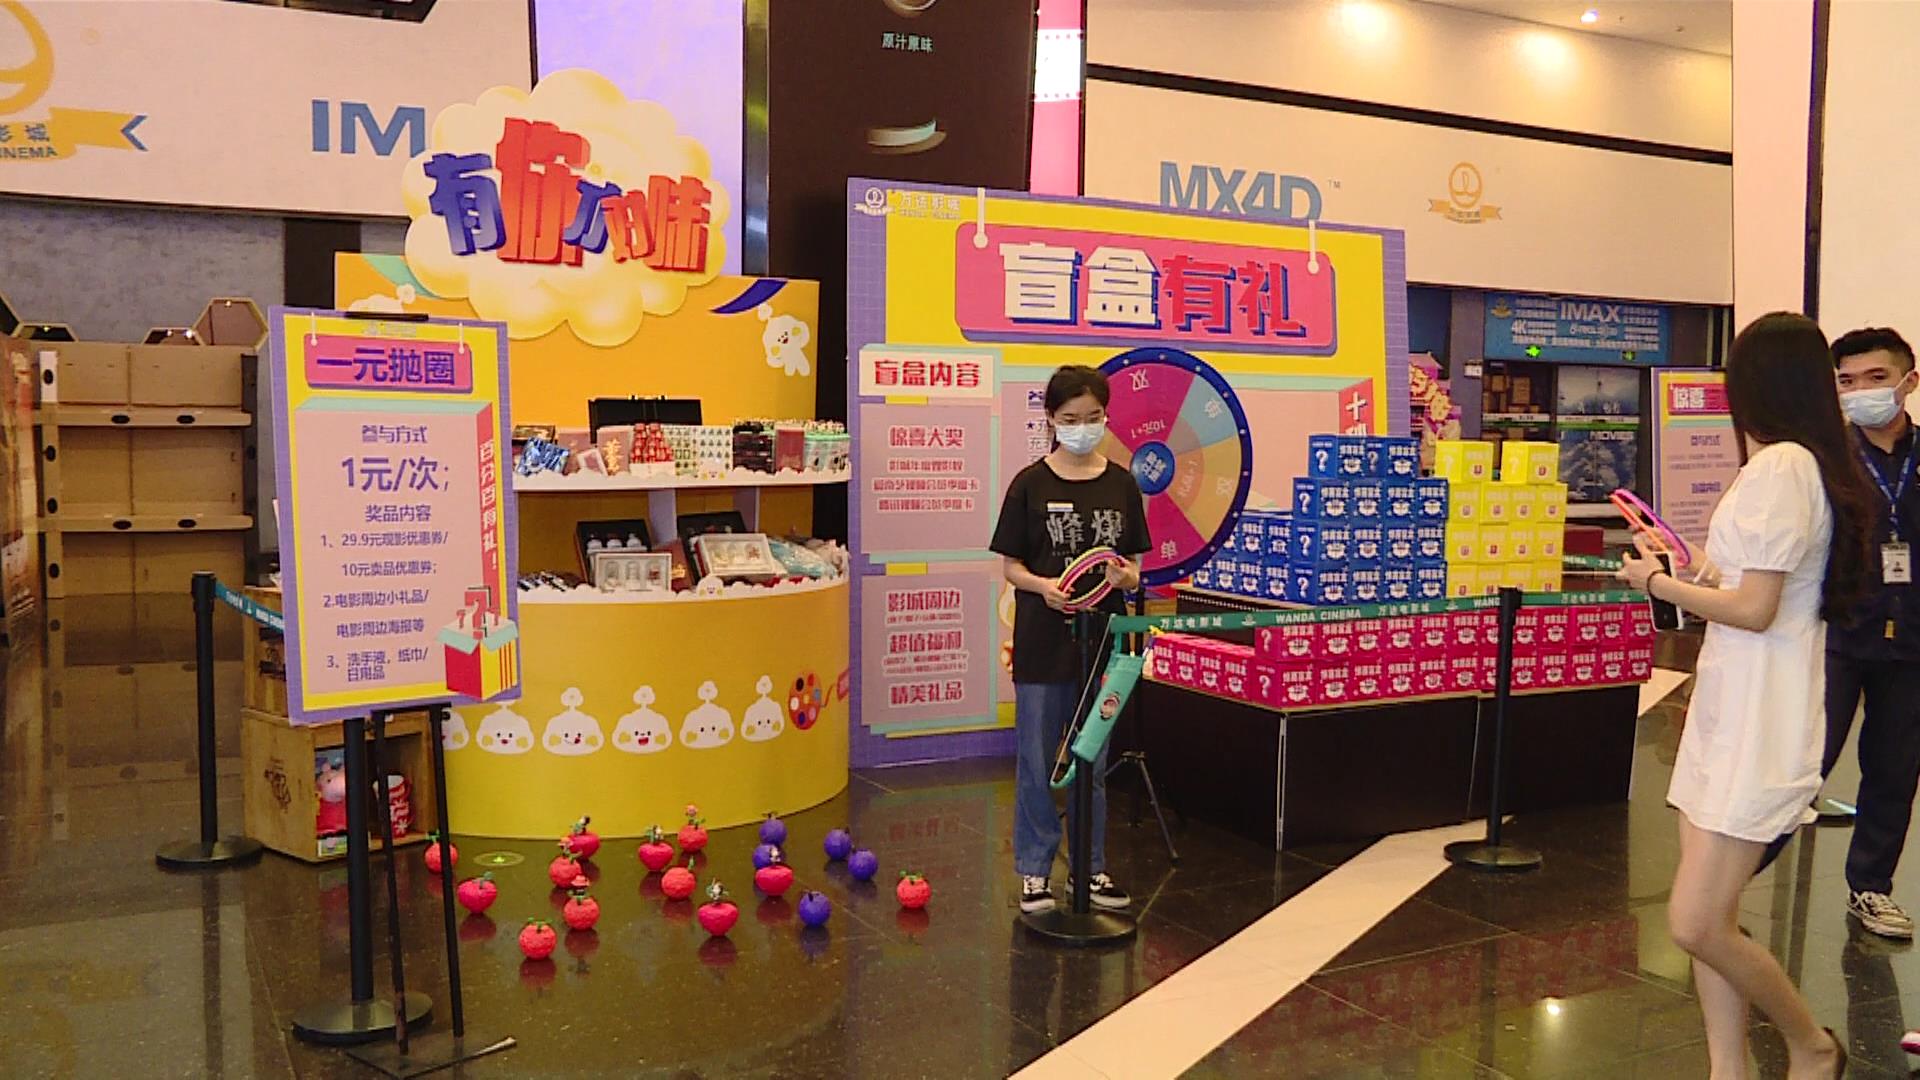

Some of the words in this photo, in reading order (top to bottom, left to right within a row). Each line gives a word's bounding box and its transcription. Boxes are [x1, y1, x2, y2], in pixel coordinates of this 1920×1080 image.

[1160, 161, 1322, 220] MX4D
[999, 241, 1307, 338] 盲盒有礼
[1561, 302, 1620, 323] IMAX
[316, 347, 455, 385] 一元抛圈
[874, 360, 979, 387] 盲盒内容
[362, 425, 428, 443] 参与方式
[890, 427, 963, 447] 惊喜大奖
[365, 505, 432, 523] 奖品内容
[888, 591, 960, 612] 影城周边
[1276, 612, 1316, 624] WANDA
[1321, 609, 1361, 620] CINEMA
[1474, 597, 1500, 608] WAND
[336, 618, 425, 638] 电影周边海报等
[890, 631, 962, 653] 超值福利
[347, 666, 386, 682] 日用品
[891, 682, 962, 704] 精美礼品
